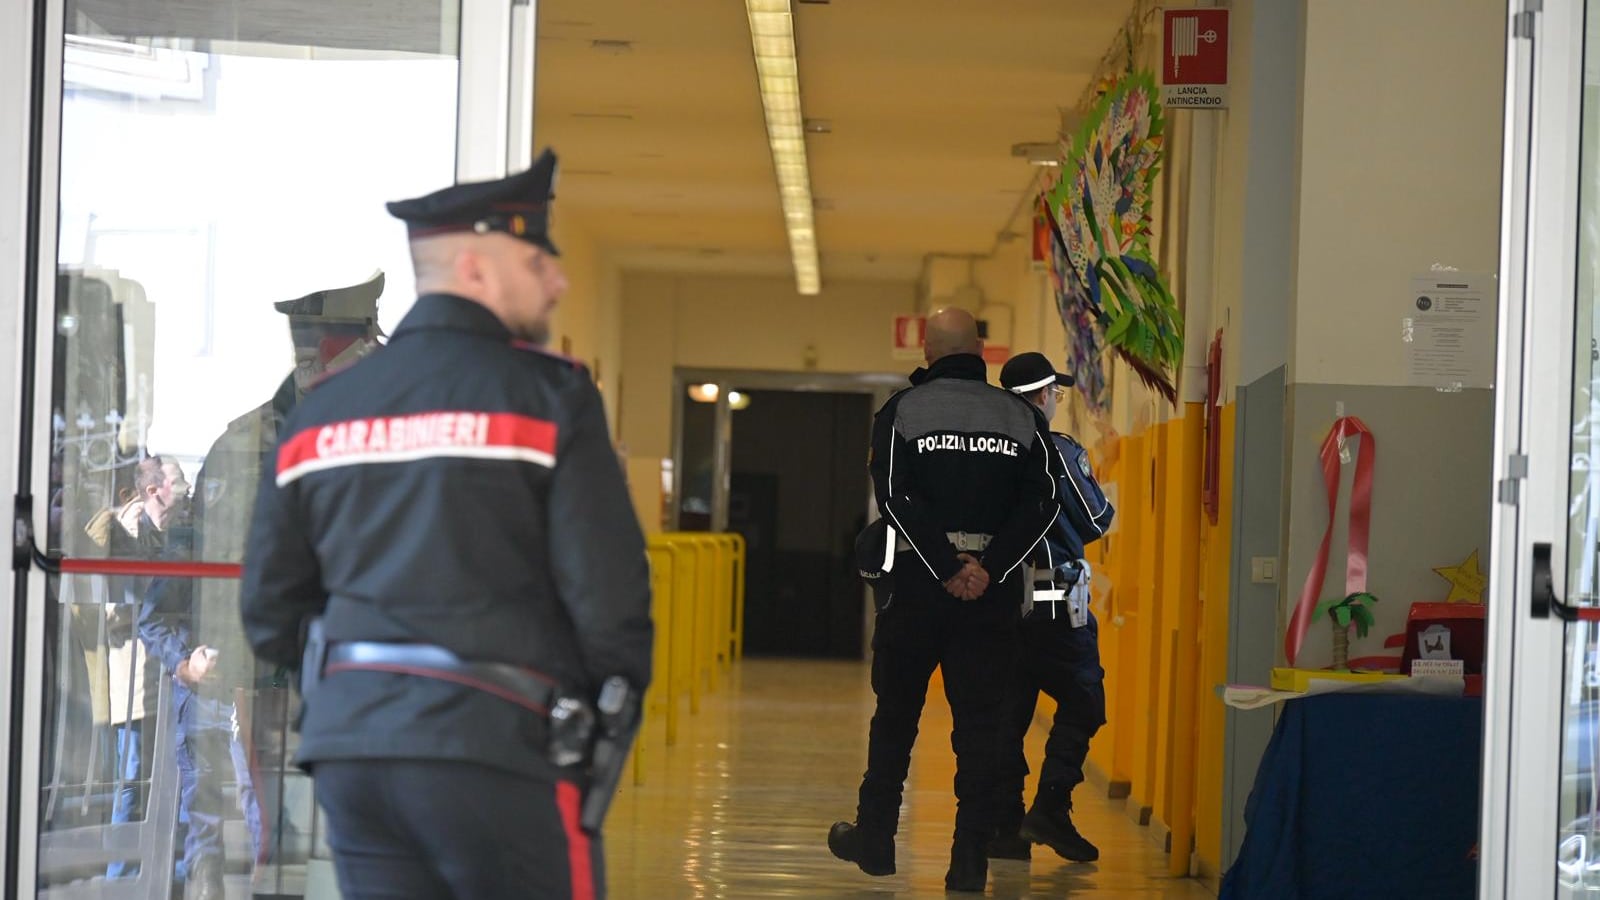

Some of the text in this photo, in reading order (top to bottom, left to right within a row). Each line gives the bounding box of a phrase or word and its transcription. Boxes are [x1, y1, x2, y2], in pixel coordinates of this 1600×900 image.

[1177, 87, 1208, 95] LANCIA
[1166, 96, 1222, 105] ANTINCENDIO
[315, 412, 490, 459] CARABINIERI
[917, 434, 1018, 457] POLIZIA LOCALE
